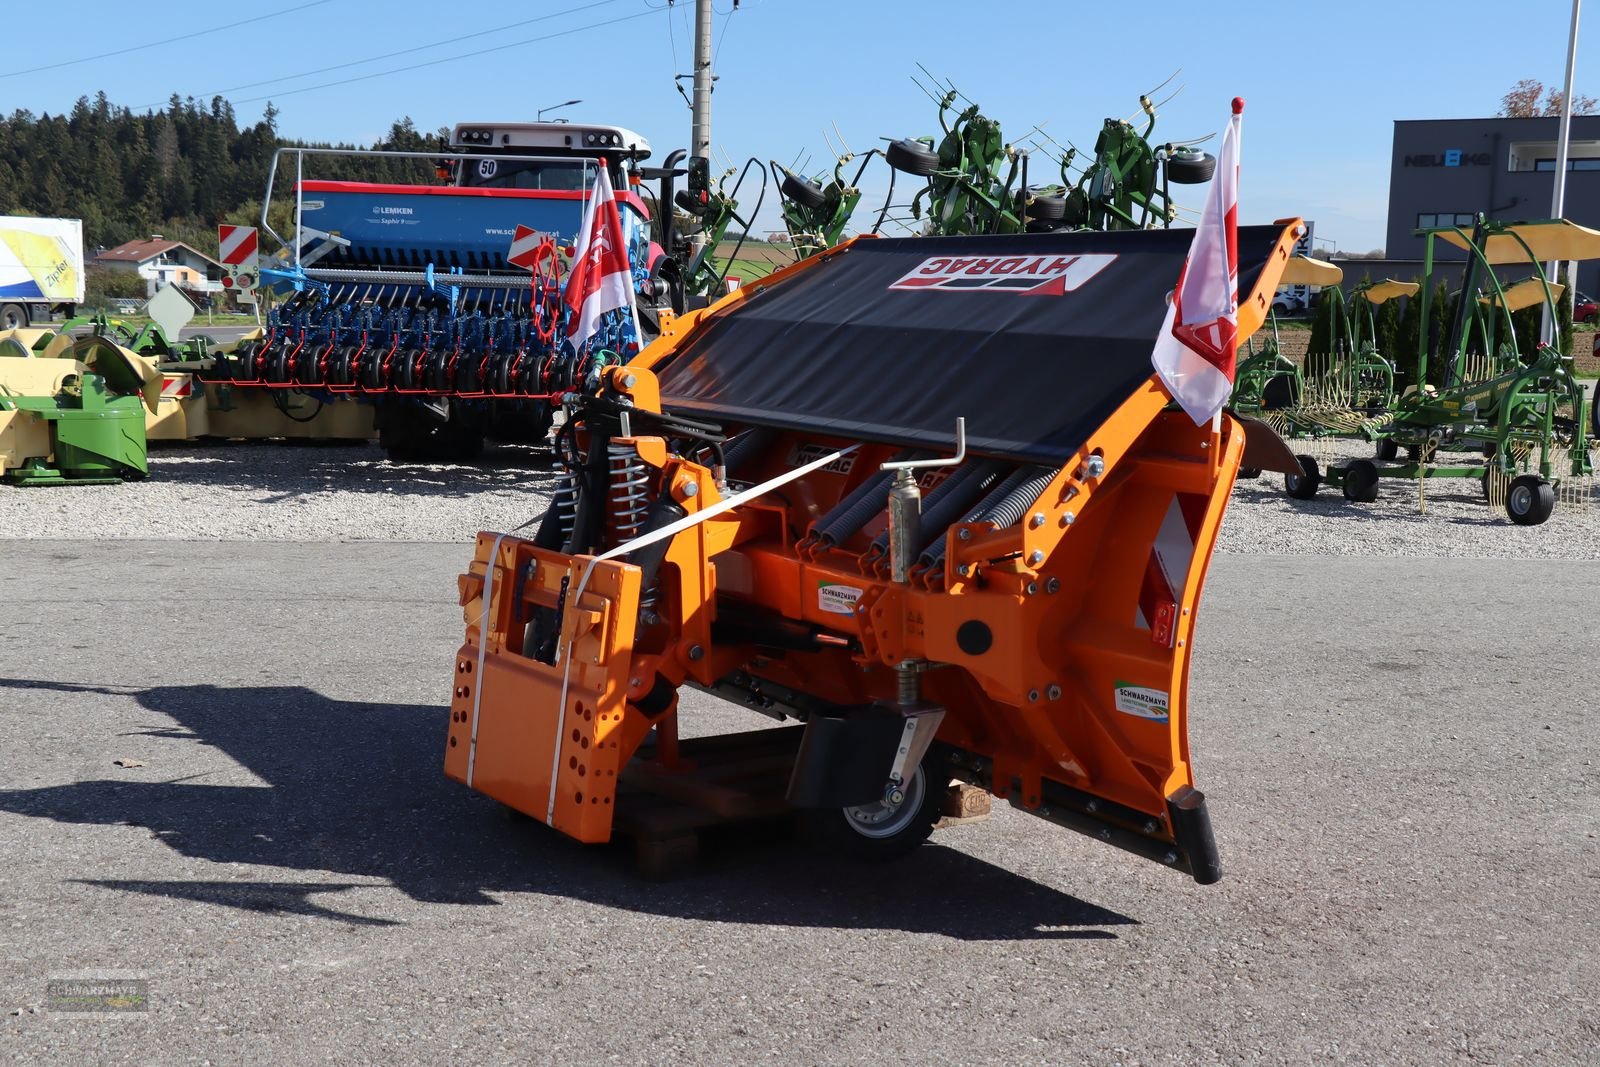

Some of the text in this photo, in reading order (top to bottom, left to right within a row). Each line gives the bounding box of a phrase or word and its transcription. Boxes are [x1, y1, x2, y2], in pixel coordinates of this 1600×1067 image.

[481, 160, 495, 175] 50
[381, 207, 413, 215] LEMKEN
[45, 259, 68, 287] Zipfer
[919, 256, 1081, 276] HYDRAC
[822, 588, 857, 601] SCHWARZMAYR
[1120, 688, 1167, 706] SCHWARZMAYR
